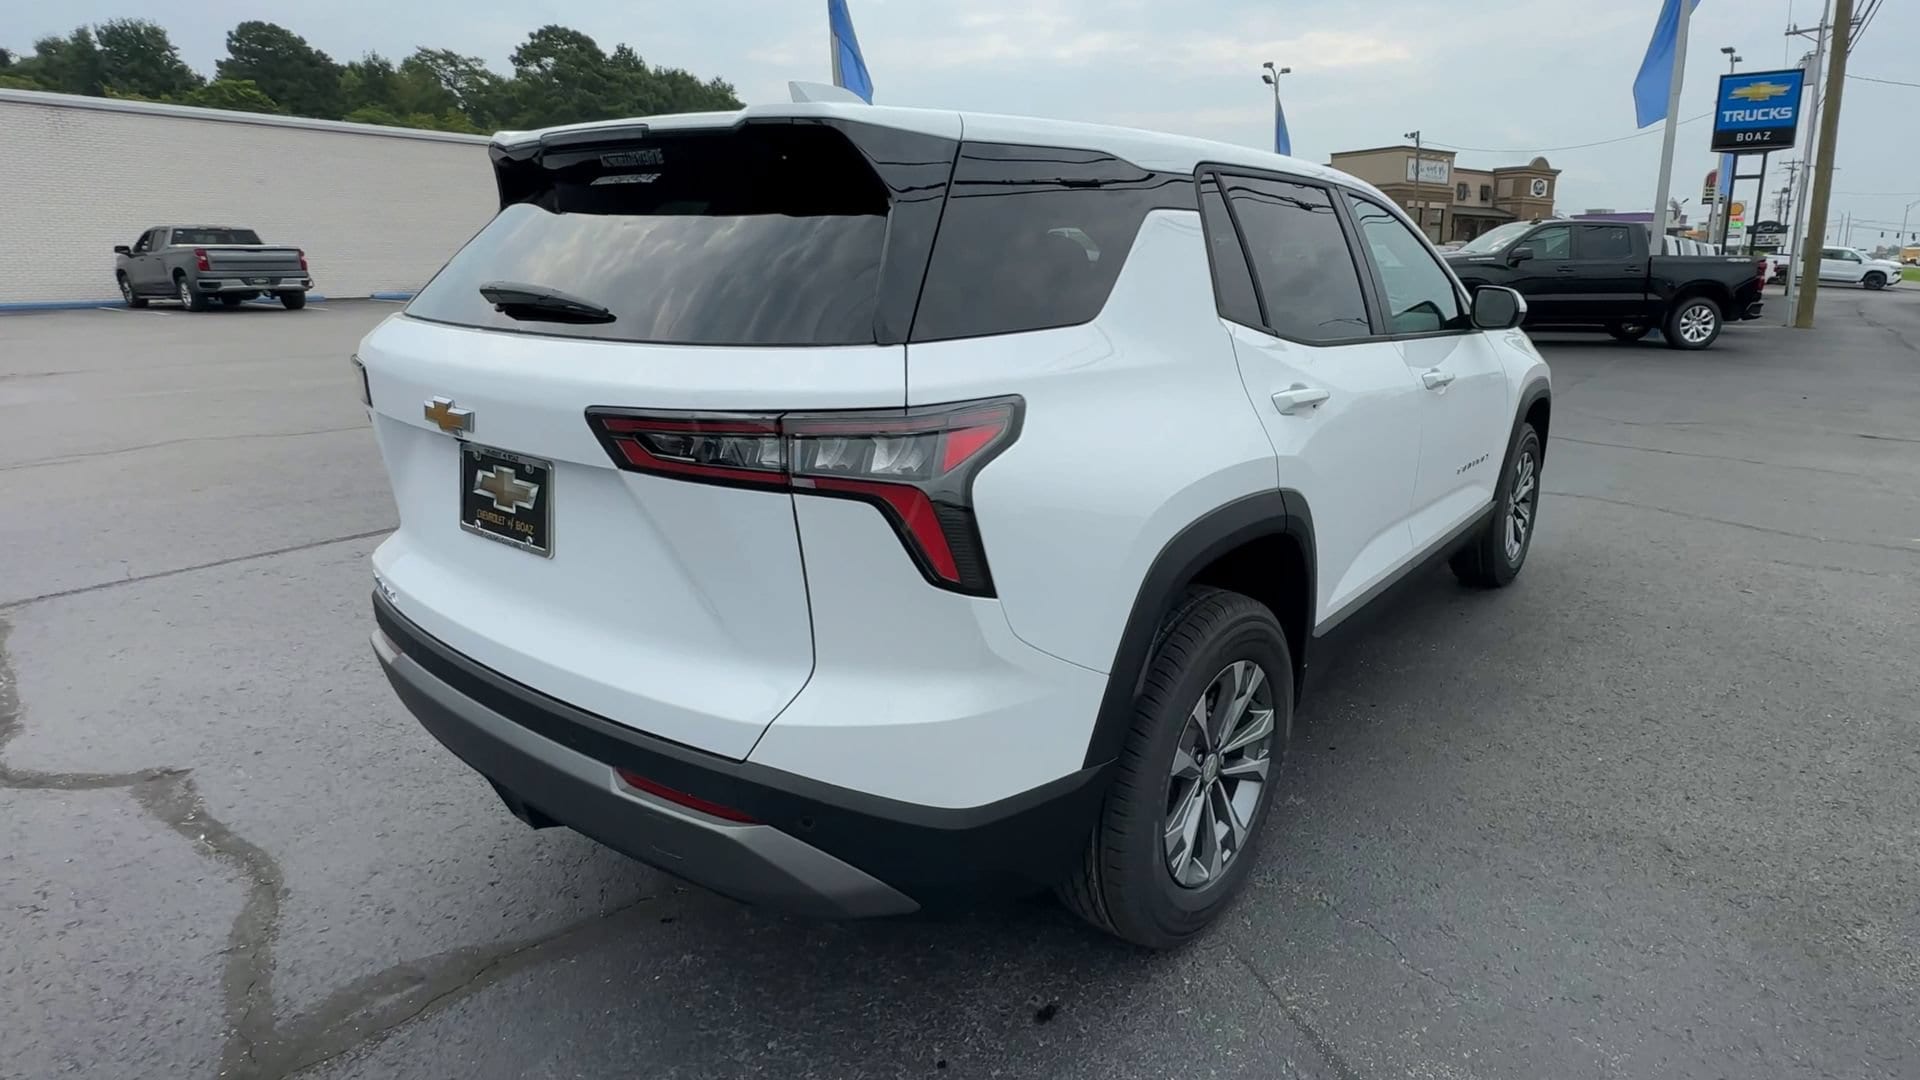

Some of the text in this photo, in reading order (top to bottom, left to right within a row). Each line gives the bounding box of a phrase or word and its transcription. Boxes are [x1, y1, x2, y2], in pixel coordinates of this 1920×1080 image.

[1722, 107, 1792, 122] TRUCKS
[1736, 131, 1771, 141] BOAZ
[477, 509, 505, 525] CHEVROLET
[516, 521, 535, 535] BOAZ
